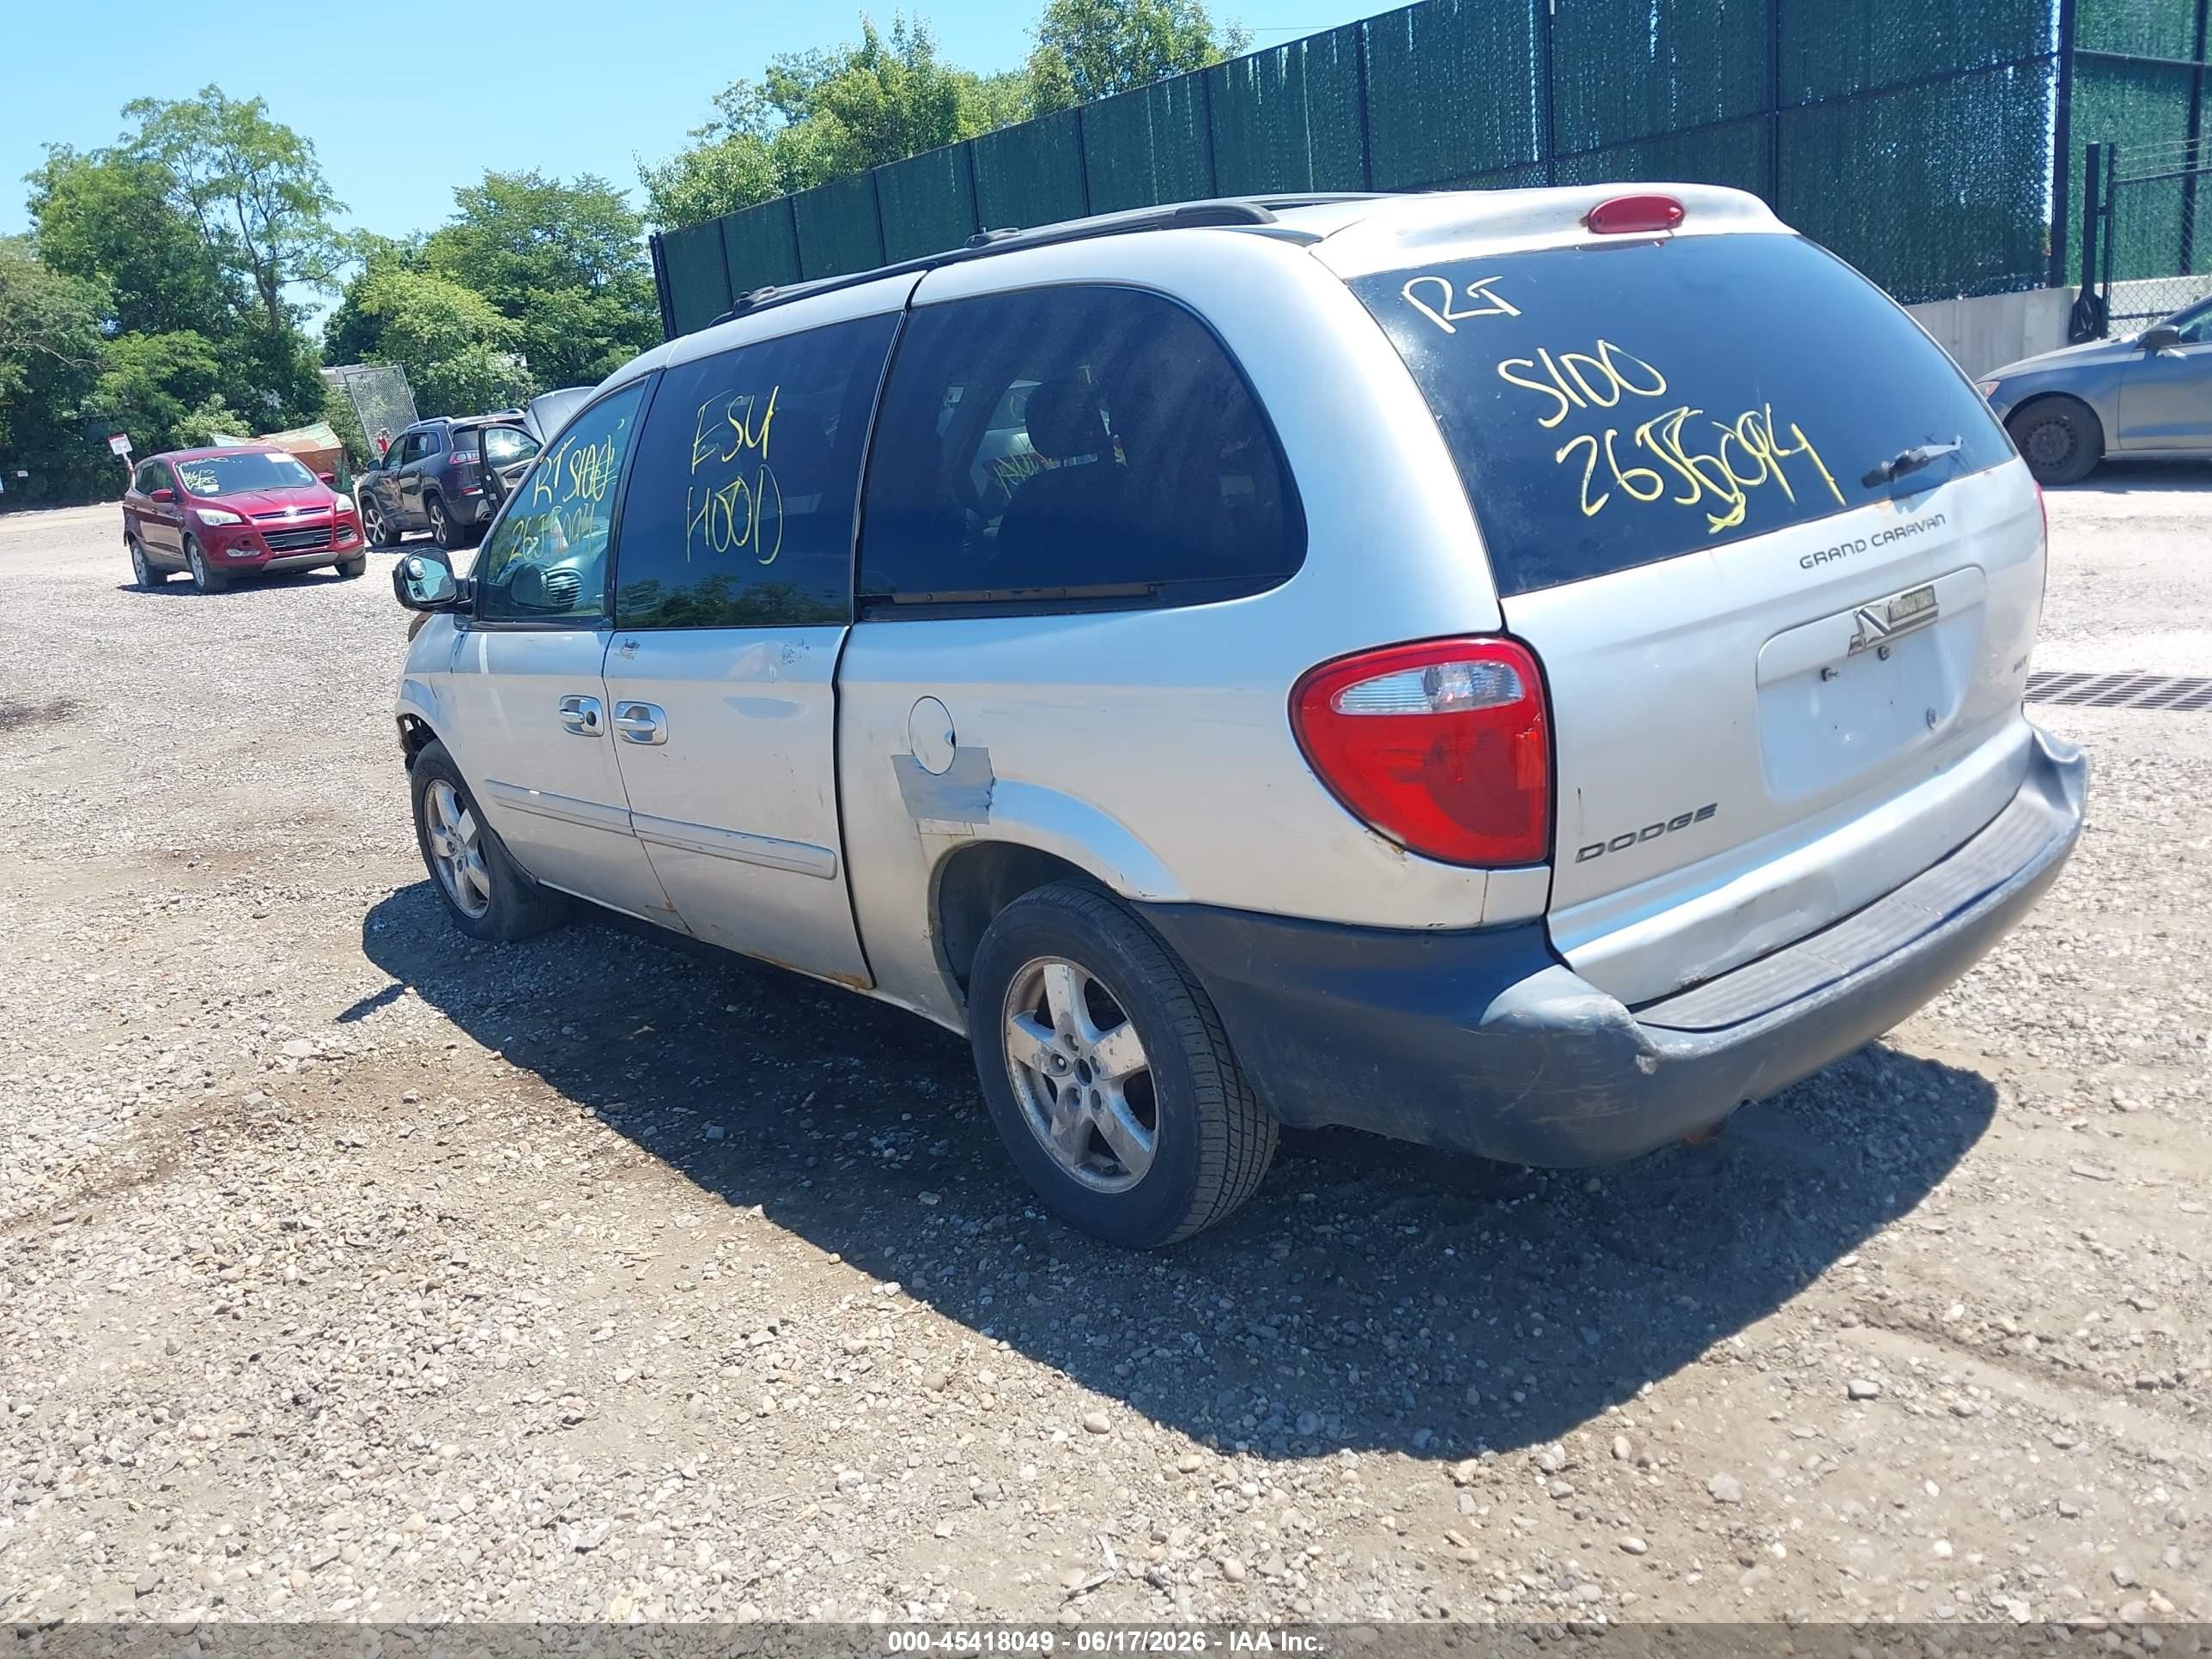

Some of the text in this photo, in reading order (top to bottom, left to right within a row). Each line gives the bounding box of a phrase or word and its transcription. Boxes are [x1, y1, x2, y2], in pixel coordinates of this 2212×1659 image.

[686, 463, 783, 565] HOOD
[1799, 513, 1948, 569] GRAND CARAVAN
[1575, 802, 1718, 864] DODGE
